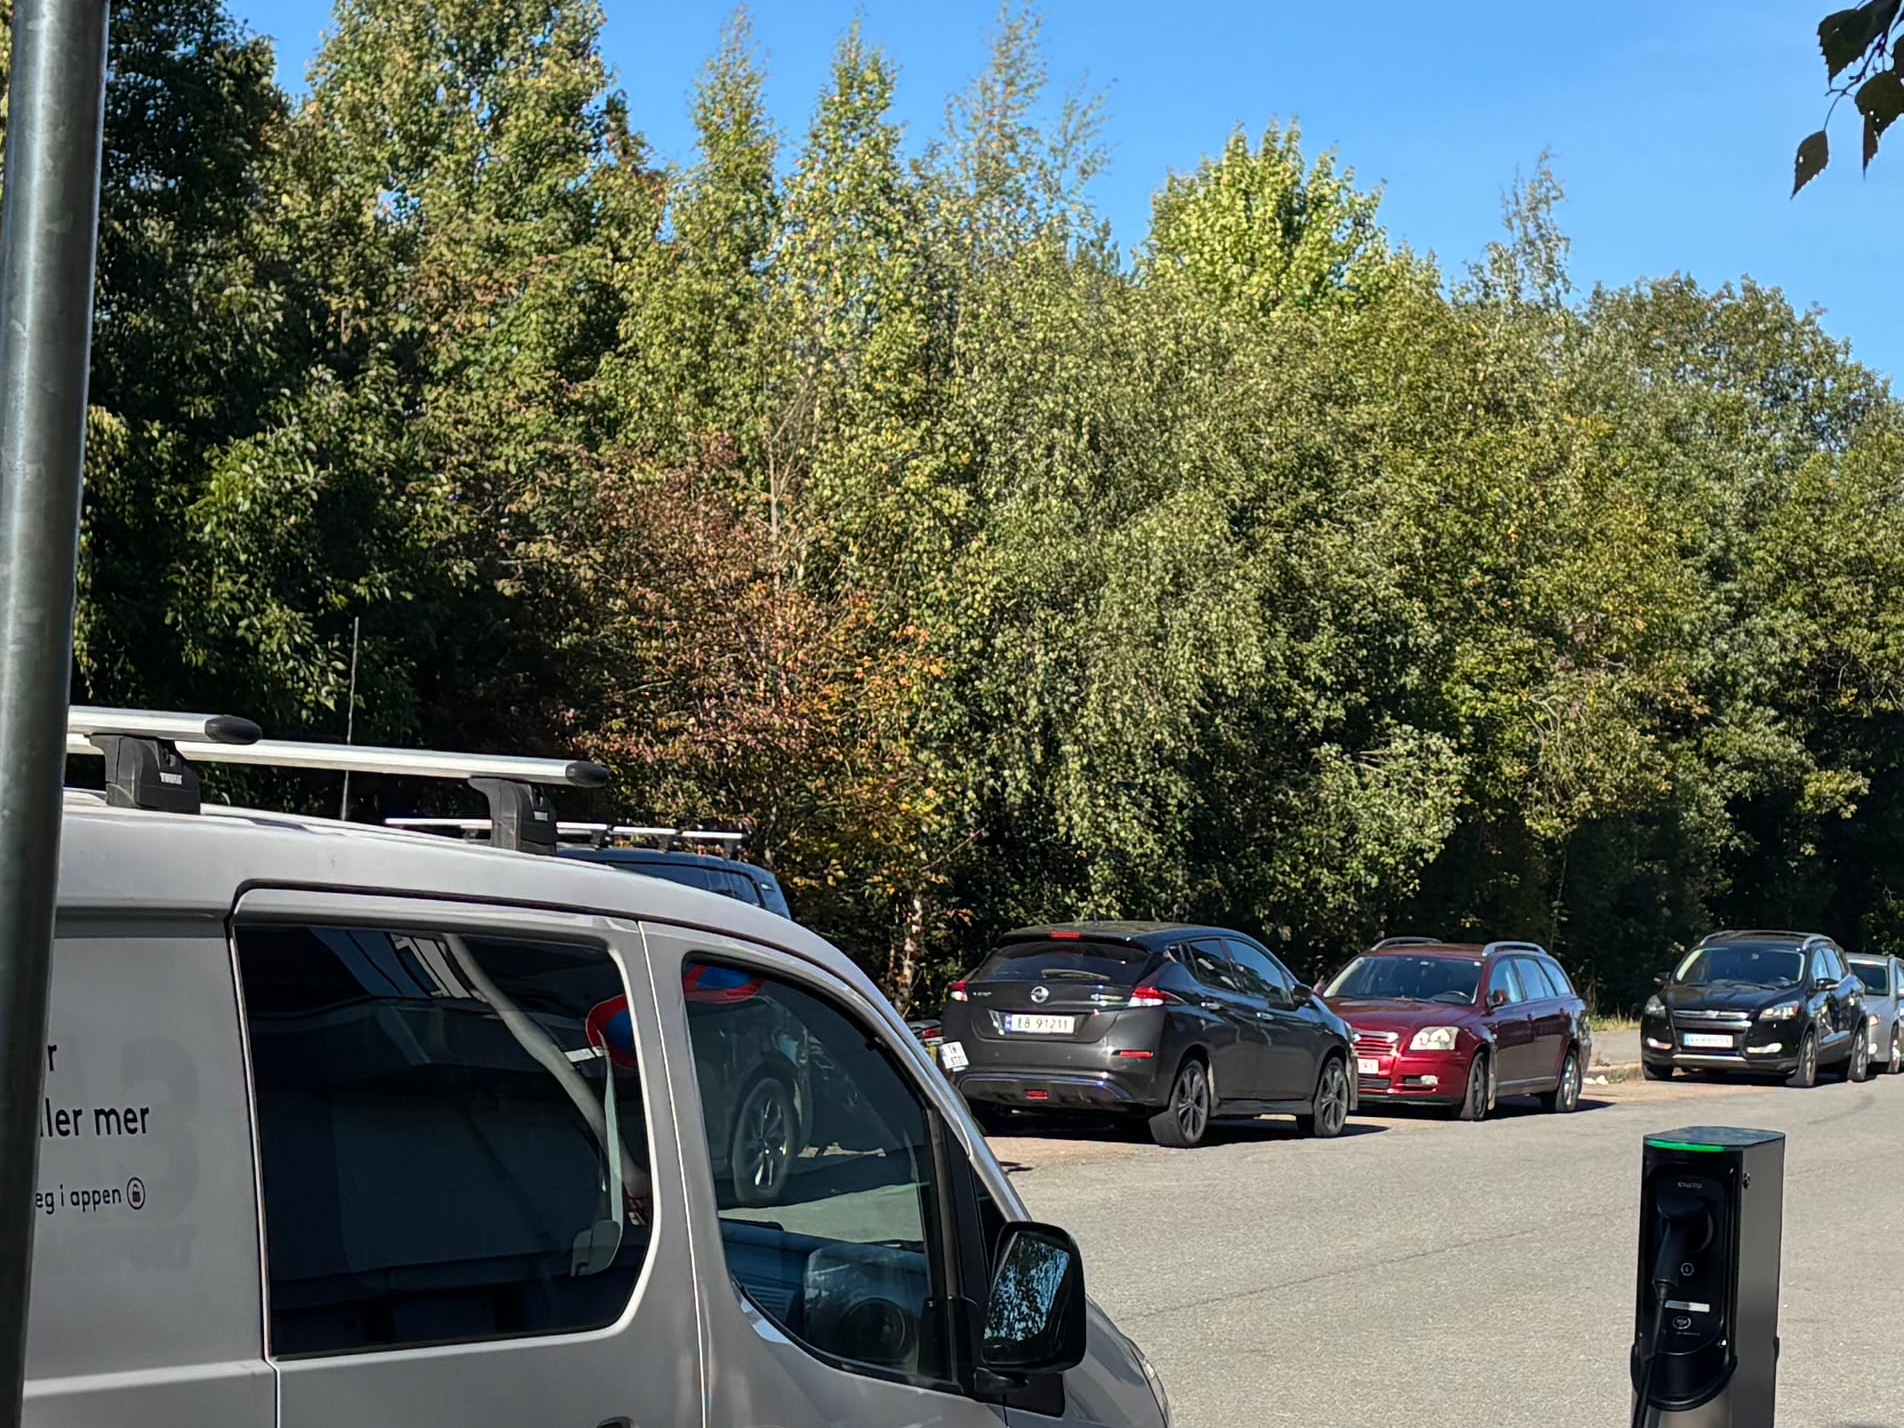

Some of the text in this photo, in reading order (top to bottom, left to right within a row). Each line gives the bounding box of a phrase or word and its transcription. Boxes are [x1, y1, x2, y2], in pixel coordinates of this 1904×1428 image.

[40, 1097, 83, 1137] ler
[94, 1105, 150, 1136] mer
[35, 1192, 54, 1215] eg
[59, 1184, 65, 1207] i
[70, 1187, 122, 1213] appen
